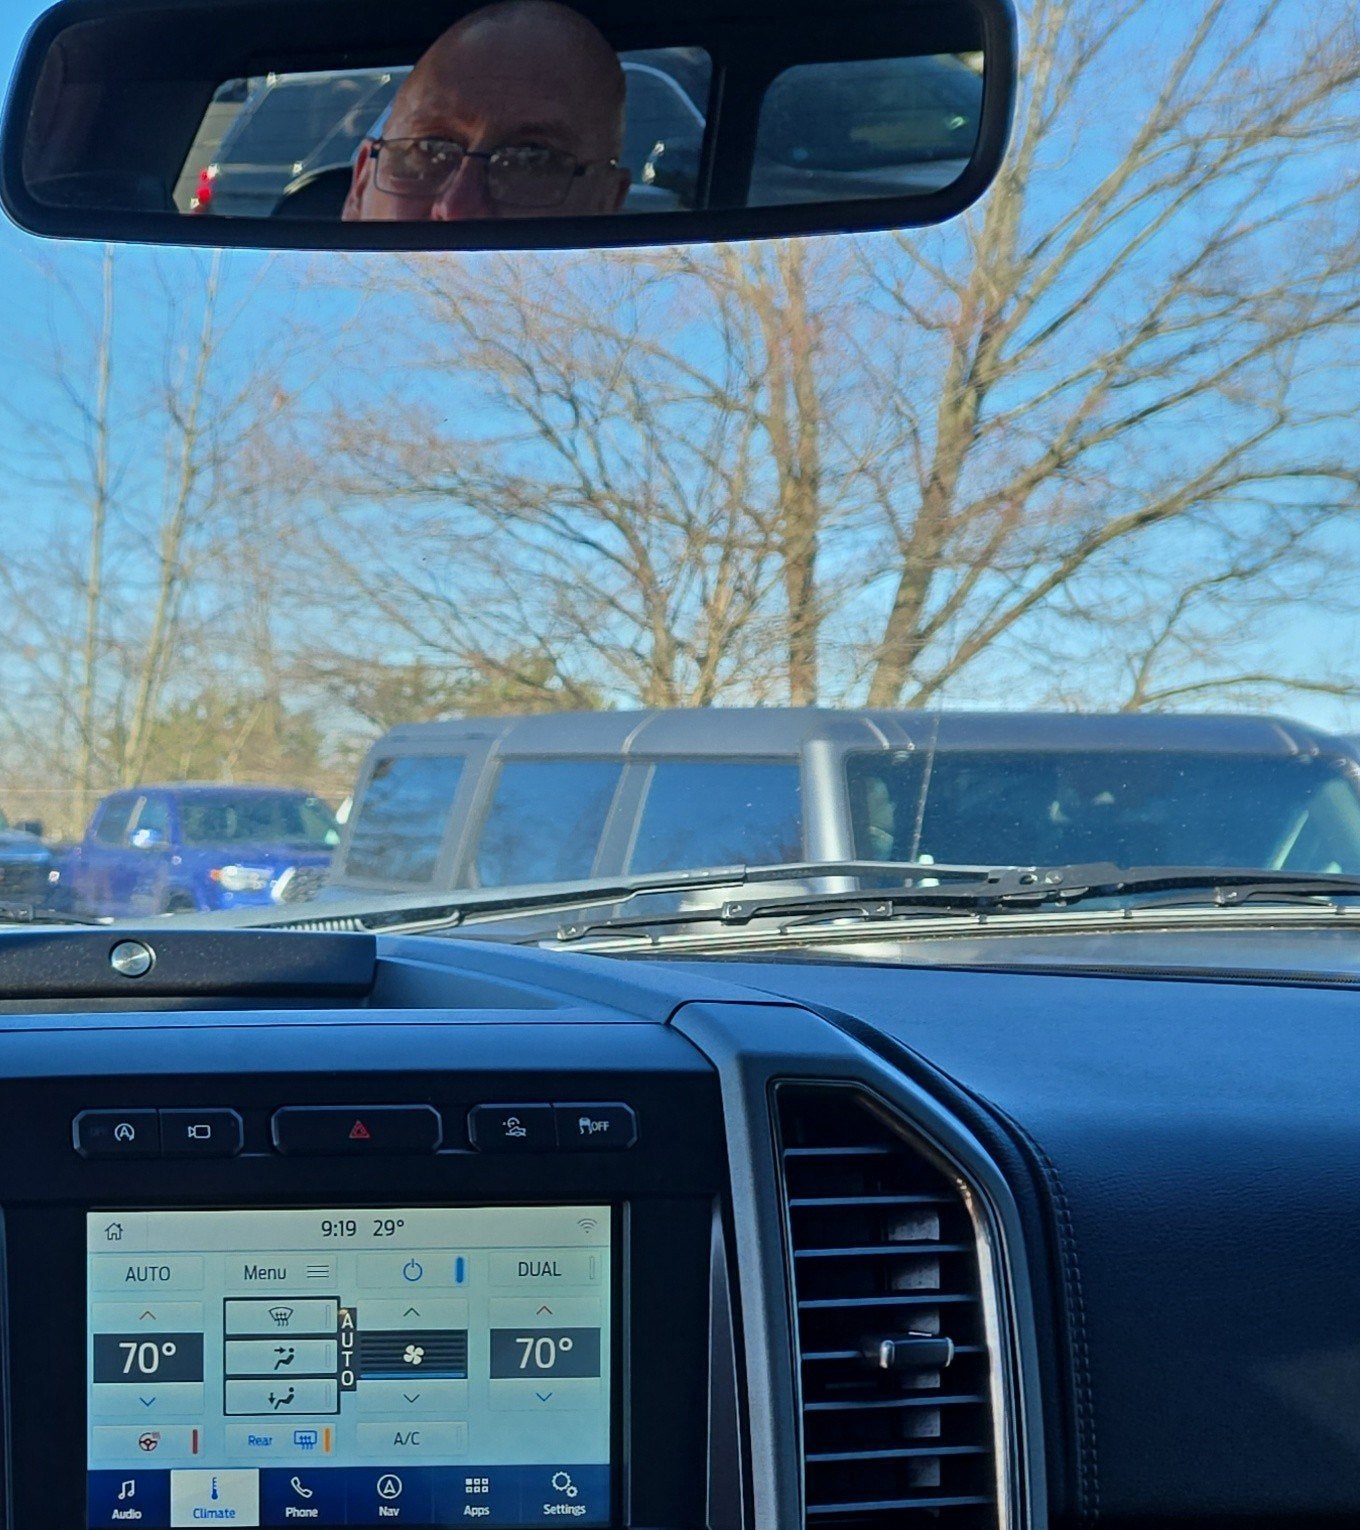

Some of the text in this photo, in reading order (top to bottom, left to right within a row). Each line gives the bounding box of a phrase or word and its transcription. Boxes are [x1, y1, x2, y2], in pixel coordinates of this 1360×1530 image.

[591, 1121, 609, 1132] OFF
[321, 1219, 405, 1237] 9:19 29°
[125, 1266, 171, 1282] AUTO
[244, 1265, 287, 1281] Menu
[518, 1261, 562, 1277] DUAL
[118, 1342, 177, 1374] 70°
[515, 1337, 573, 1370] 70°
[248, 1435, 273, 1446] Rear
[394, 1431, 420, 1446] A/C
[112, 1508, 142, 1520] Audio
[193, 1508, 236, 1520] Climate
[285, 1507, 319, 1518] Phone
[379, 1506, 400, 1517] Nav
[463, 1505, 490, 1518] Apps
[543, 1504, 586, 1517] Settings
